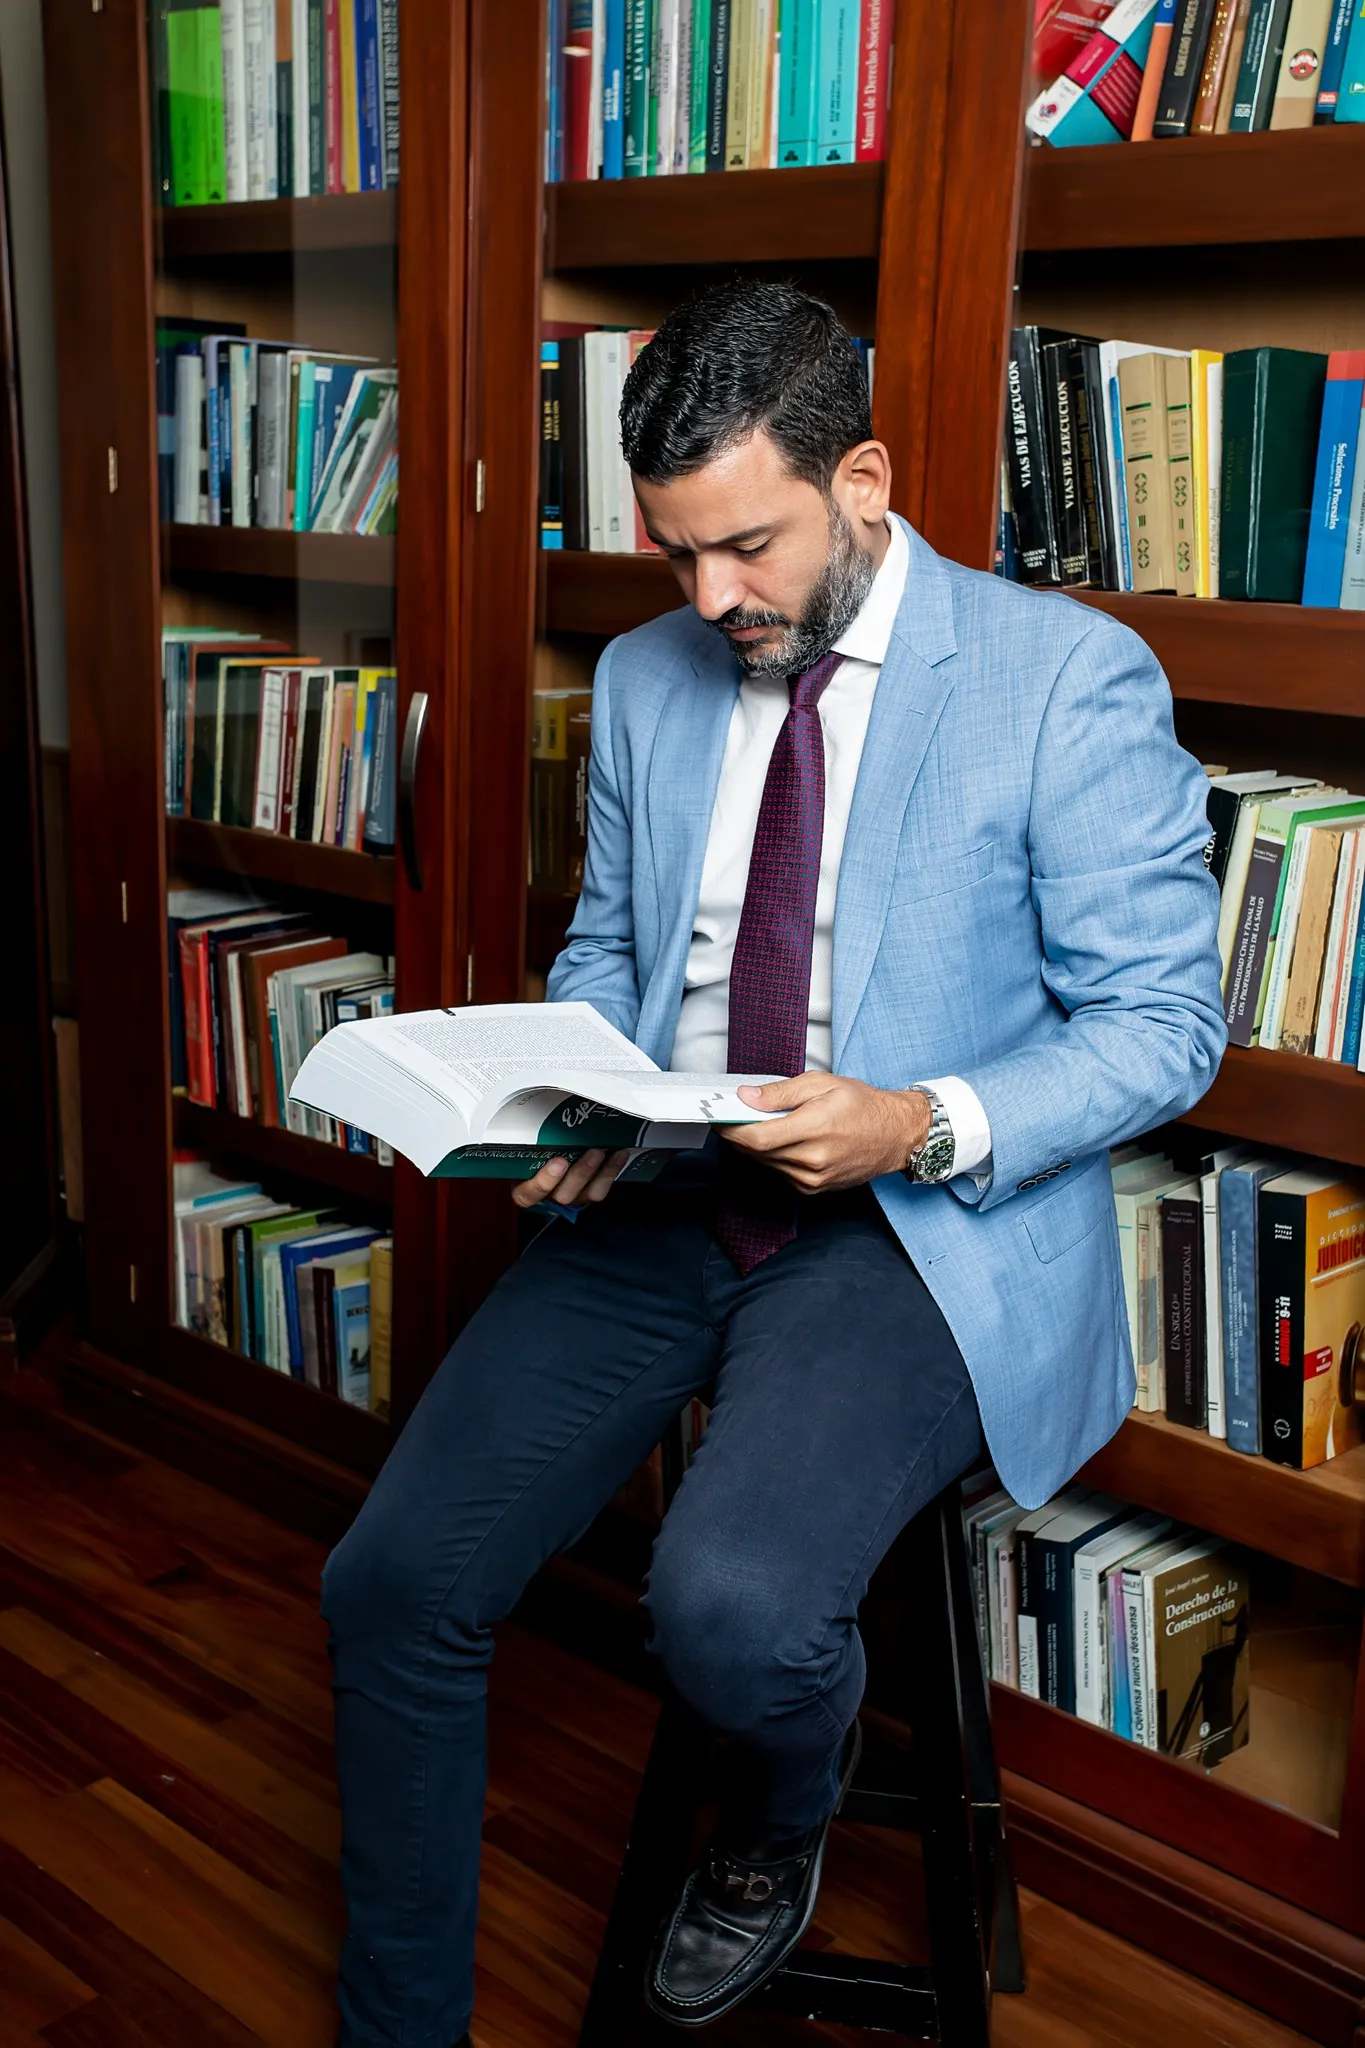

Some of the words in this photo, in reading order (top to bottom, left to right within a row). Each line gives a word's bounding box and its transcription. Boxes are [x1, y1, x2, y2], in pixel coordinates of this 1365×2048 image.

[633, 48, 644, 63] LA
[1173, 35, 1193, 78] DERECHO
[633, 66, 643, 80] EN
[865, 51, 879, 94] Derecho
[863, 97, 876, 109] de
[861, 112, 876, 150] Manual
[1007, 360, 1028, 435] EJECUCION
[1056, 380, 1073, 455] EJECUCION
[1015, 436, 1030, 456] DE
[1019, 456, 1033, 488] VIAS
[1062, 456, 1074, 476] DE
[1333, 442, 1348, 488] Soluciones
[1064, 477, 1076, 509] VIAS
[1329, 488, 1343, 531] Procesales
[1249, 894, 1258, 907] DE
[1253, 896, 1267, 923] SALUD
[1243, 906, 1255, 931] PENAL
[1252, 922, 1261, 933] LA
[1238, 936, 1249, 958] CIVIL
[1250, 932, 1259, 944] DE
[1240, 943, 1258, 1002] PROFESIONALES
[1226, 957, 1247, 1025] RESPONSABILIDAD
[1237, 1001, 1247, 1016] LOS
[1320, 1222, 1365, 1246] DICCION
[1182, 1244, 1193, 1337] CONSTITUCIONAL
[1171, 1300, 1181, 1332] SIGLO
[1280, 1296, 1291, 1319] 9-11
[1170, 1332, 1181, 1351] UN
[1166, 1592, 1210, 1620] Derecho
[1212, 1584, 1226, 1599] de
[1228, 1580, 1239, 1594] la
[1127, 1606, 1140, 1654] descansa
[1166, 1598, 1236, 1637] Construcción
[1132, 1656, 1142, 1687] nunca
